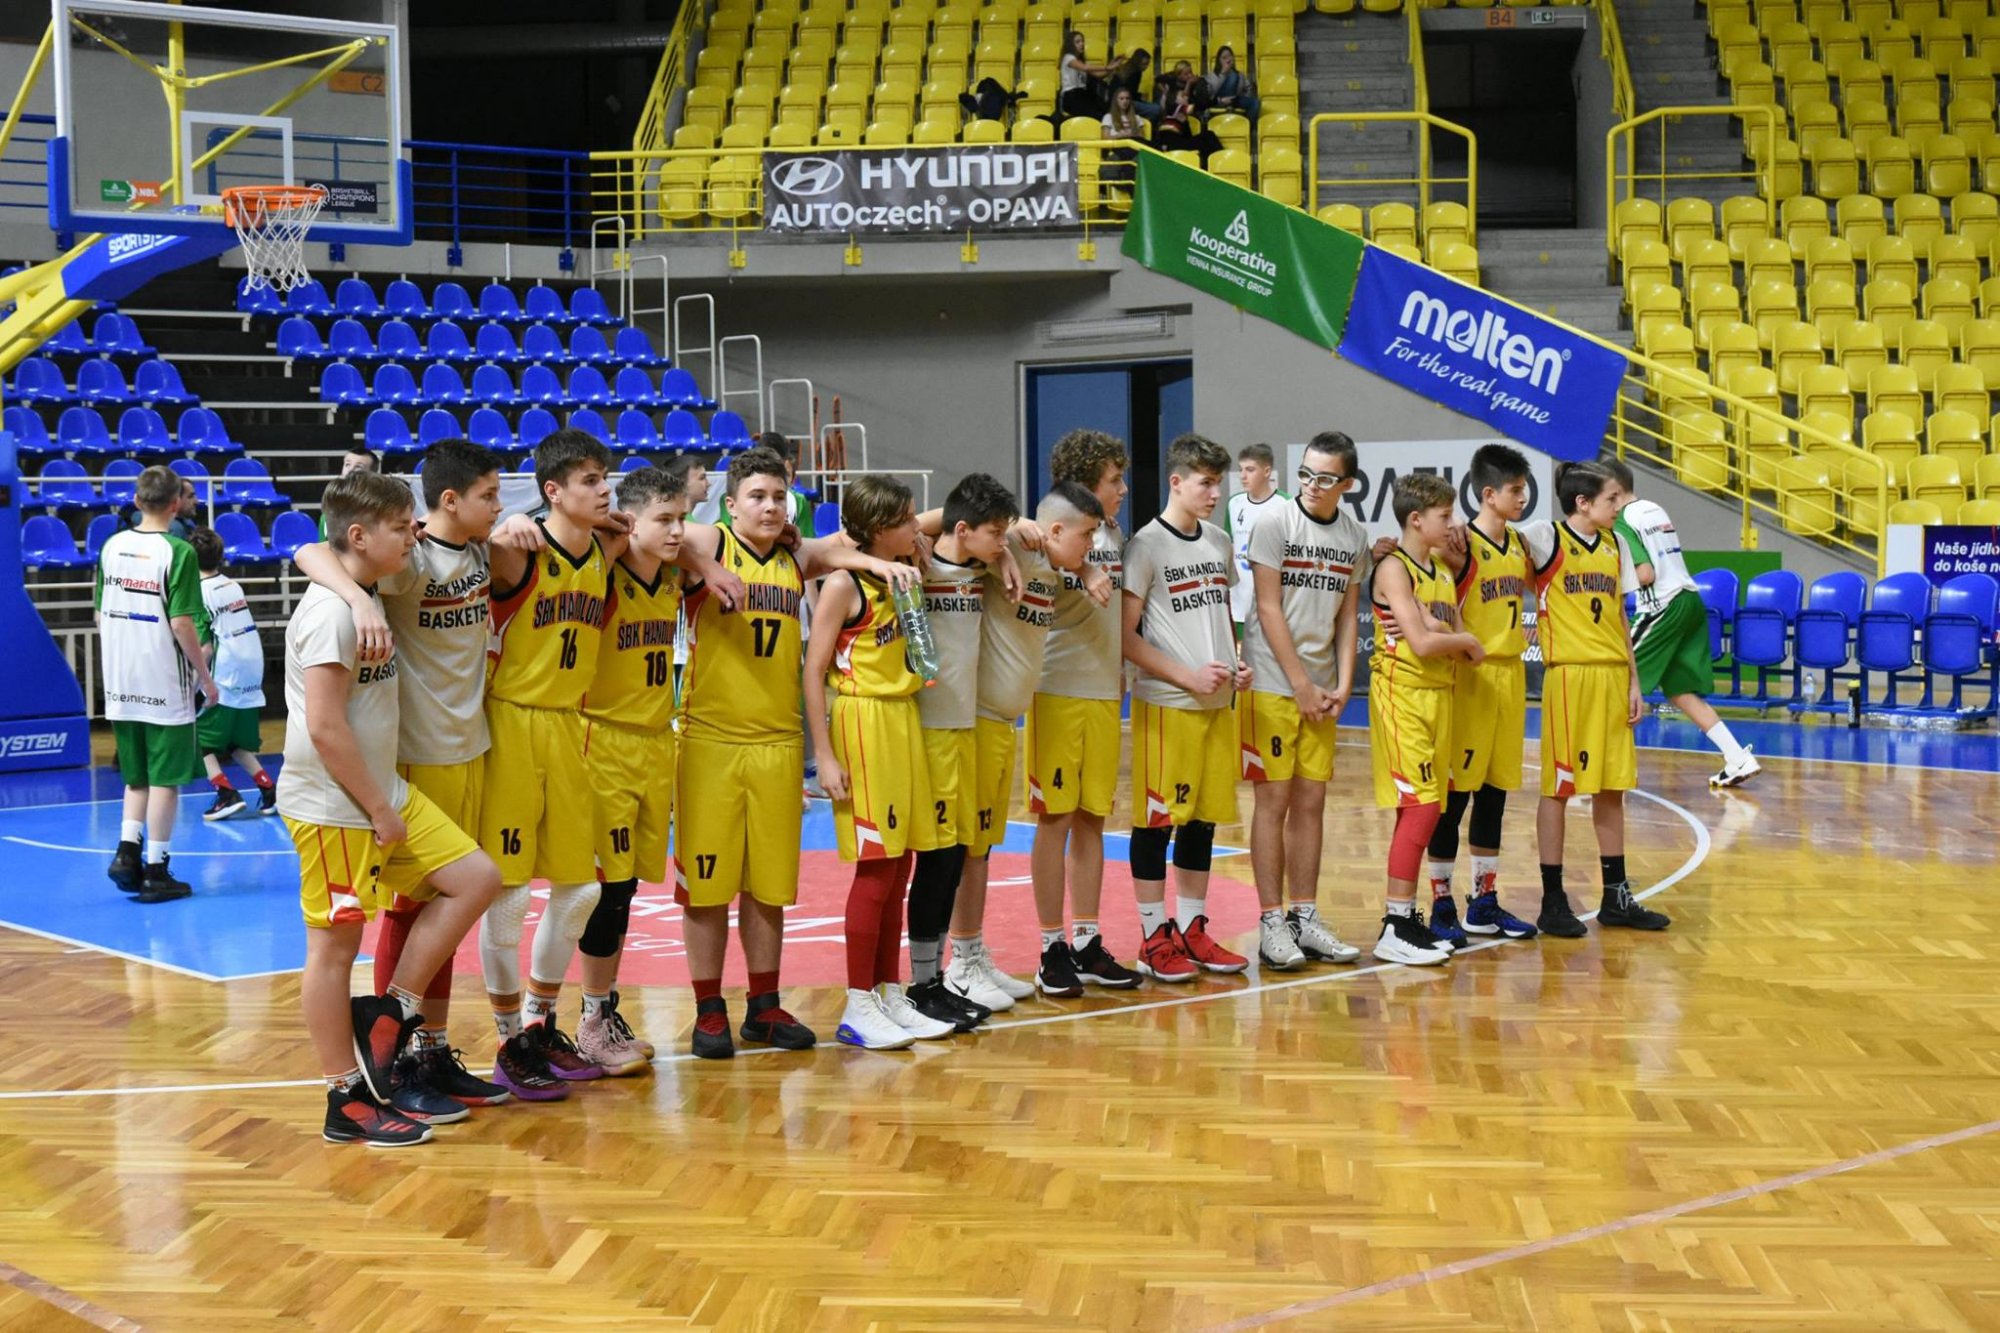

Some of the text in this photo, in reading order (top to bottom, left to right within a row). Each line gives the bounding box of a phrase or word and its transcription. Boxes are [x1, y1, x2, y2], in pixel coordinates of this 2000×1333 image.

[1489, 11, 1511, 26] B4
[862, 152, 1069, 189] HYUNDAI
[331, 187, 370, 195] BASKETBALL
[331, 193, 375, 202] CHAMPIONS
[331, 200, 355, 208] LEAGUE
[968, 195, 1074, 223] OPAVA
[1189, 226, 1277, 277] Kooperativa
[1186, 254, 1273, 297] VIENNA INSURANCE GROUP
[1384, 336, 1551, 424] For the real game
[1237, 508, 1245, 527] 4
[1933, 542, 1968, 556] Naše
[1164, 565, 1188, 582] ŠBK
[1933, 559, 1952, 573] do
[1954, 559, 1987, 573] koše
[1508, 601, 1518, 629] 7
[1591, 597, 1603, 624] 9
[560, 628, 577, 670] 16
[750, 617, 782, 657] 17
[643, 650, 668, 687] 10
[1271, 735, 1282, 757] 8
[1463, 749, 1474, 770] 7
[1579, 750, 1589, 771] 9
[1052, 767, 1063, 789] 4
[1418, 762, 1432, 783] 11
[1175, 783, 1191, 804] 12
[887, 804, 897, 830] 6
[935, 800, 947, 824] 2
[500, 828, 521, 855] 16
[609, 827, 630, 854] 10
[696, 854, 717, 879] 17
